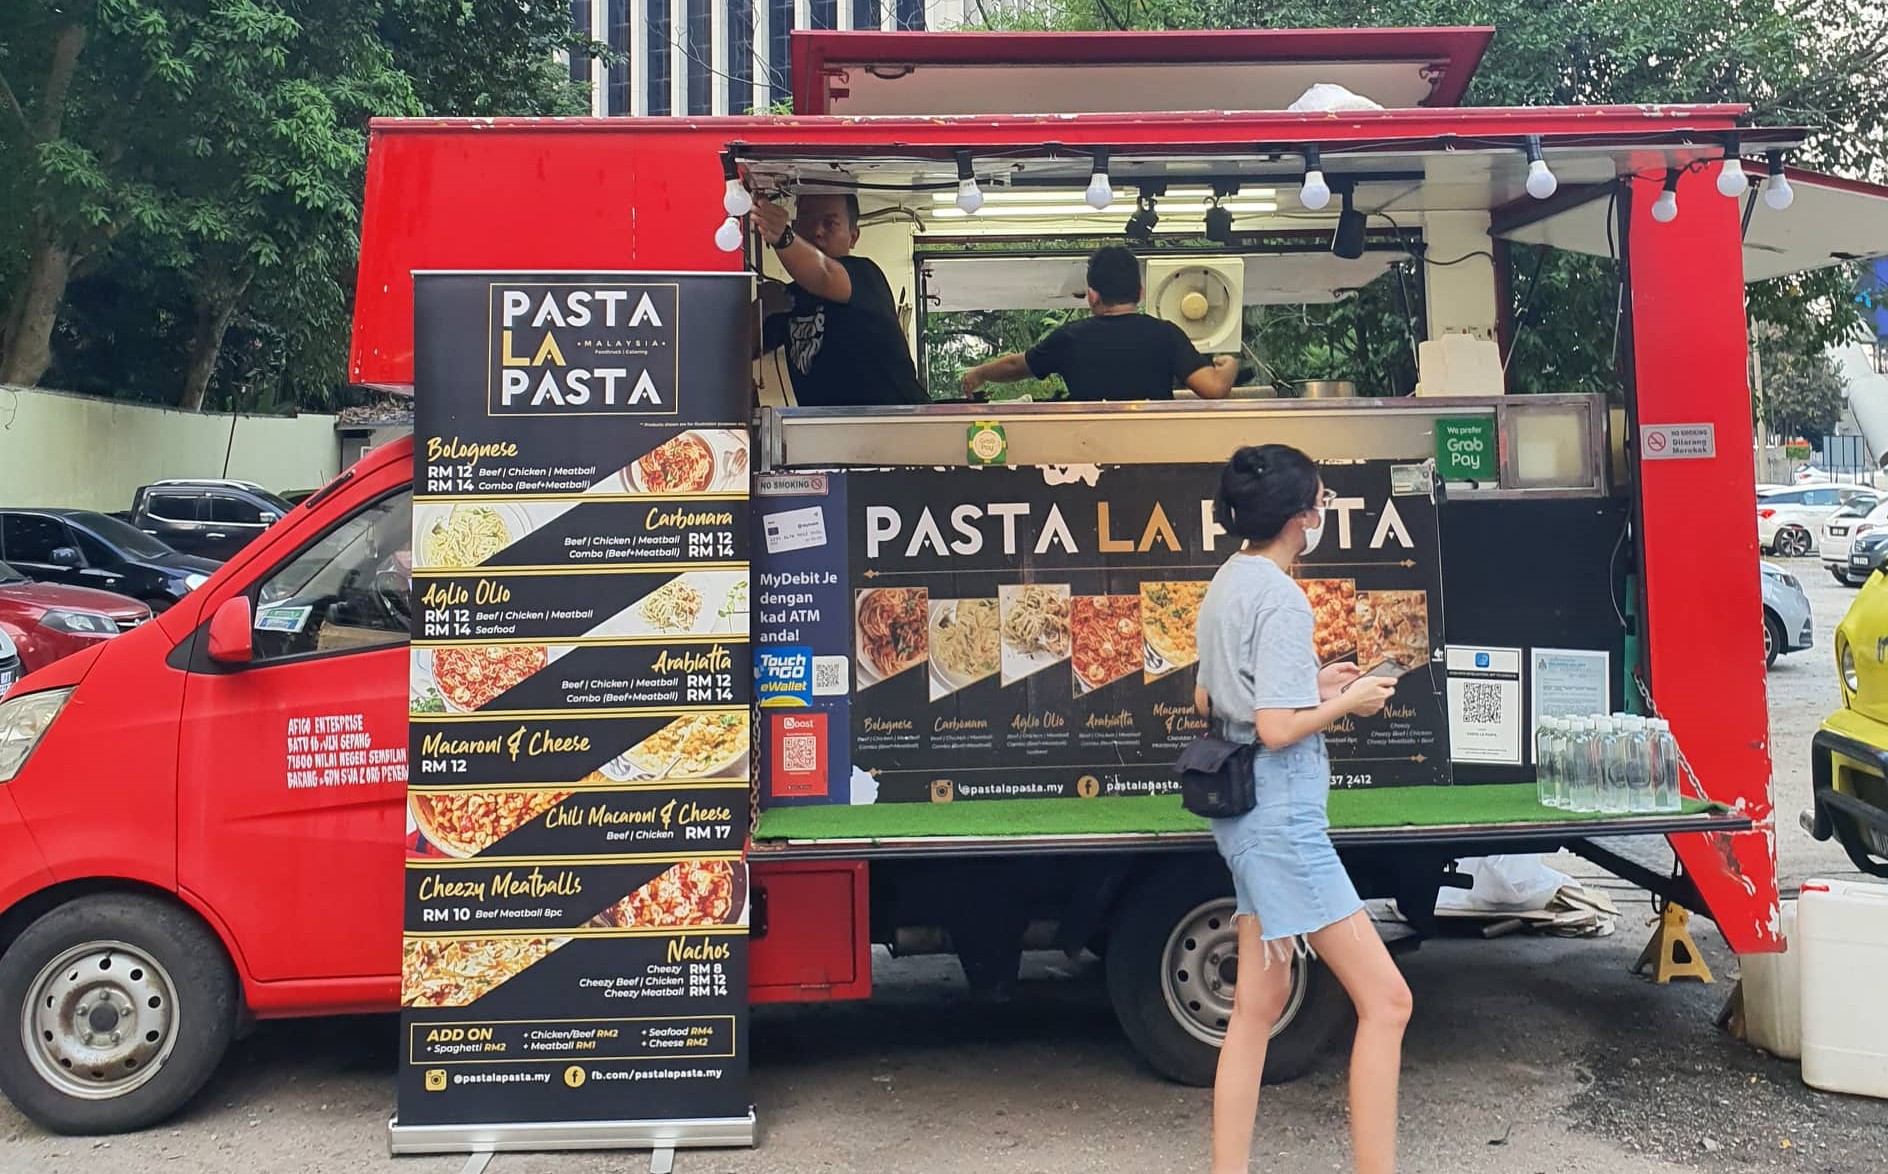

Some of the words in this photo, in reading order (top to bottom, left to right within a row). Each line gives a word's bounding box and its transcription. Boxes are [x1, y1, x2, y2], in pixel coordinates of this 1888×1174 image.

[503, 291, 663, 326] PASTA
[503, 330, 566, 366] LA
[502, 369, 662, 405] PASTA
[1460, 427, 1483, 435] prefer
[1447, 437, 1484, 452] Grab
[1672, 438, 1707, 447] Dilarang
[427, 436, 518, 466] Bolognese
[1672, 446, 1707, 454] Merokok
[1451, 453, 1481, 469] Pay
[427, 466, 453, 477] RM
[457, 466, 473, 477] 12
[479, 467, 501, 476] Beef
[508, 467, 546, 476] Chicken
[553, 466, 596, 475] Meatball
[427, 479, 453, 491] RM
[457, 479, 474, 491] 14
[479, 481, 513, 490] Combo
[515, 480, 591, 491] (Beef+Meatball)
[760, 481, 772, 490] NO
[773, 480, 810, 490] SMOKING
[645, 507, 733, 530] Carbonara
[866, 502, 1080, 559] PASTA
[1097, 501, 1183, 553] LA
[1201, 498, 1415, 551] PTA
[564, 537, 587, 546] Beef
[592, 536, 631, 545] Chicken
[638, 535, 681, 544] Meatball
[688, 533, 713, 544] RM
[717, 532, 733, 544] 12
[569, 550, 603, 558] Combo
[605, 548, 681, 559] (Beef+Meatball)
[688, 546, 713, 557] RM
[718, 545, 734, 557] 14
[760, 571, 820, 588] MyDebit
[822, 571, 838, 584] Je
[422, 582, 468, 613] Aglio
[475, 579, 511, 605] Olio
[760, 592, 813, 607] dengan
[425, 610, 449, 622] RM
[454, 610, 470, 622] 12
[476, 612, 500, 621] Beef
[505, 611, 544, 620] Chicken
[551, 610, 593, 619] Meatball
[760, 610, 786, 623] kad
[789, 609, 820, 623] ATM
[425, 624, 449, 636] RM
[454, 624, 471, 635] 14
[475, 625, 516, 634] Seafood
[760, 629, 800, 642] anda!
[651, 644, 732, 675] Arabiatta
[761, 654, 807, 667] Touch
[561, 680, 585, 689] Beef
[590, 679, 629, 689] Chicken
[636, 678, 679, 687] Meatball
[687, 675, 712, 687] RM
[716, 674, 732, 687] 12
[760, 680, 808, 692] eWallet
[566, 694, 601, 703] Combo
[603, 692, 679, 704] (Beef+Meatball)
[687, 689, 712, 701] RM
[716, 688, 733, 701] 14
[1383, 702, 1417, 719] Nachos
[314, 714, 363, 734] ENTERPRISE
[863, 717, 913, 734] Bolognese
[934, 716, 988, 732] Carbonara
[1011, 713, 1040, 732] Aglio
[1043, 710, 1065, 728] Olio
[287, 736, 309, 754] BATU
[340, 732, 371, 750] SEPANG
[422, 731, 502, 758] Macaroni
[528, 730, 591, 756] Cheese
[314, 752, 337, 769] NILAI
[339, 750, 367, 767] NEGERI
[369, 748, 407, 765] SEMBILAN
[422, 760, 447, 773] RM
[451, 760, 467, 772] 12
[1346, 774, 1372, 785] 2412
[961, 783, 1064, 796] @pastalapasta.my
[545, 805, 584, 828] Chili
[588, 804, 657, 827] Macaroni
[678, 801, 732, 825] Cheese
[606, 831, 631, 841] Beef
[636, 829, 674, 840] Chicken
[685, 826, 711, 839] RM
[715, 825, 731, 839] 17
[419, 874, 486, 901] Cheezy
[491, 867, 582, 898] Meatballs
[423, 908, 449, 921] RM
[453, 908, 471, 921] 10
[475, 909, 499, 919] Beef
[500, 908, 543, 918] Meatball
[544, 908, 563, 920] 8pc
[667, 935, 731, 963] Nachos
[647, 965, 682, 974] Cheezy
[689, 964, 710, 974] RM
[714, 963, 722, 973] 8
[579, 978, 615, 988] Cheezy
[616, 977, 639, 987] Beef
[645, 976, 684, 986] Chicken
[689, 975, 710, 985] RM
[714, 975, 726, 985] 12
[604, 989, 640, 998] Cheezy
[641, 987, 685, 997] Meatball
[689, 986, 710, 996] RM
[714, 985, 728, 996] 14
[426, 1029, 465, 1042] ADD
[467, 1028, 493, 1041] ON
[530, 1029, 596, 1040] Chicken/Beef
[596, 1029, 619, 1038] RM2
[648, 1027, 689, 1037] Seafood
[690, 1027, 713, 1035] RM4
[434, 1043, 483, 1055] Spaghetti
[484, 1043, 506, 1052] RM2
[530, 1041, 574, 1050] Meatball
[576, 1041, 596, 1050] RM1
[649, 1039, 685, 1048] Cheese
[686, 1038, 708, 1047] RM2
[453, 1071, 551, 1084] @pastalapasta.my
[591, 1068, 723, 1080] fb.com/pastalapasta.my
